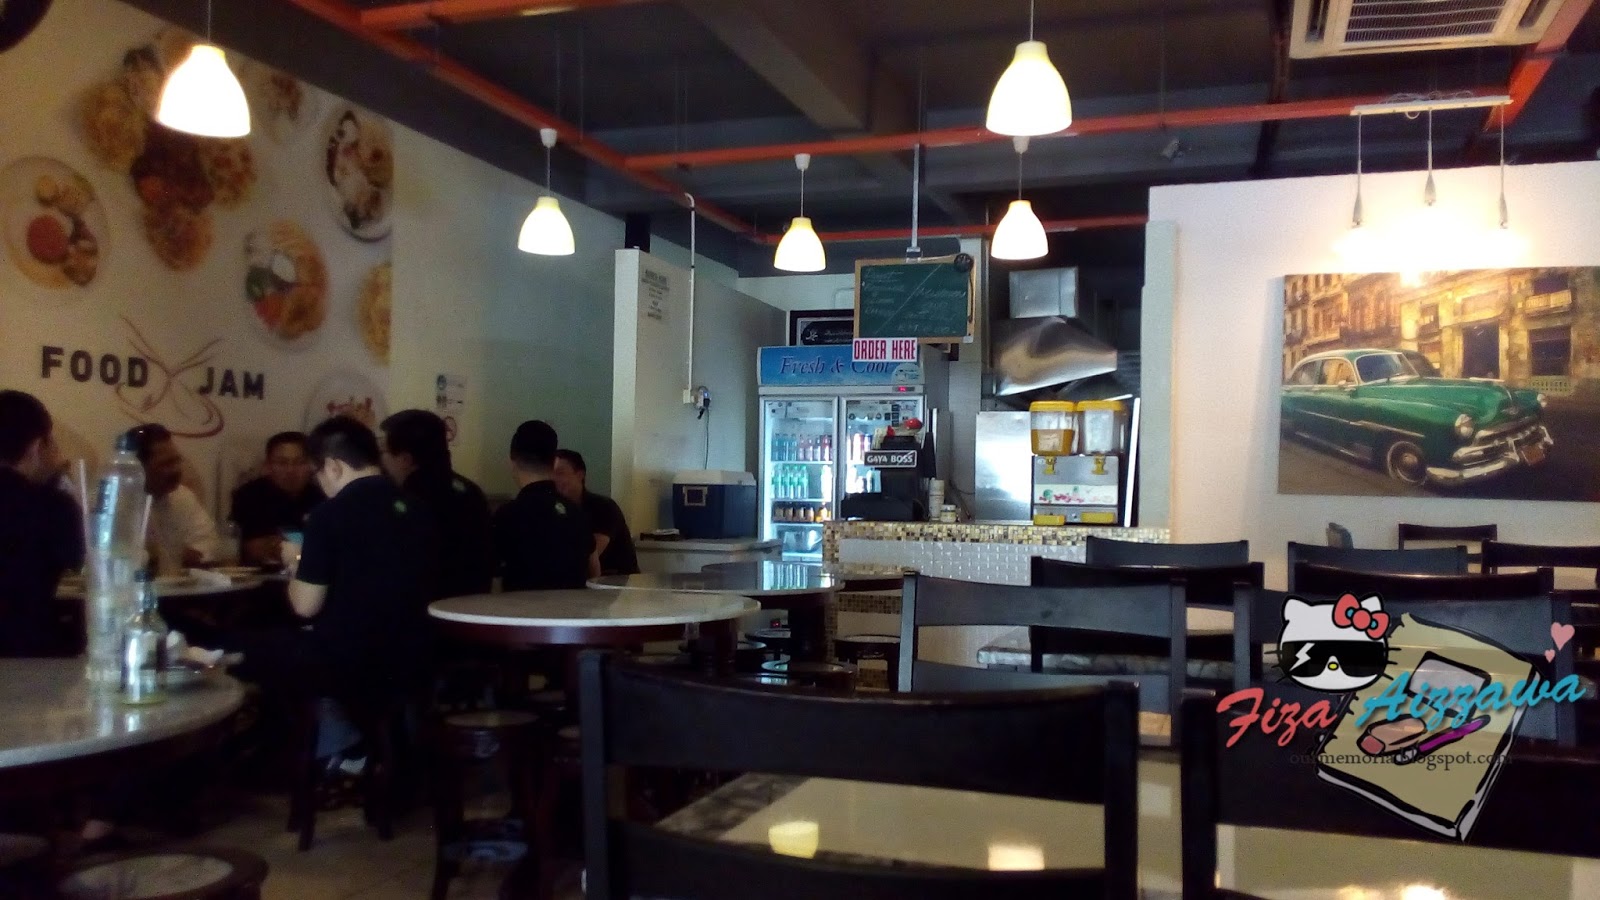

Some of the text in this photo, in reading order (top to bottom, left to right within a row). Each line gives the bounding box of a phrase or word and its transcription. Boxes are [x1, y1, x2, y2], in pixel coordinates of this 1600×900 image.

[854, 339, 916, 360] ORDER HERE
[42, 346, 265, 401] FOOD JAM
[780, 355, 825, 375] Fresh
[831, 357, 845, 374] &
[866, 454, 914, 464] GAYA BOSS
